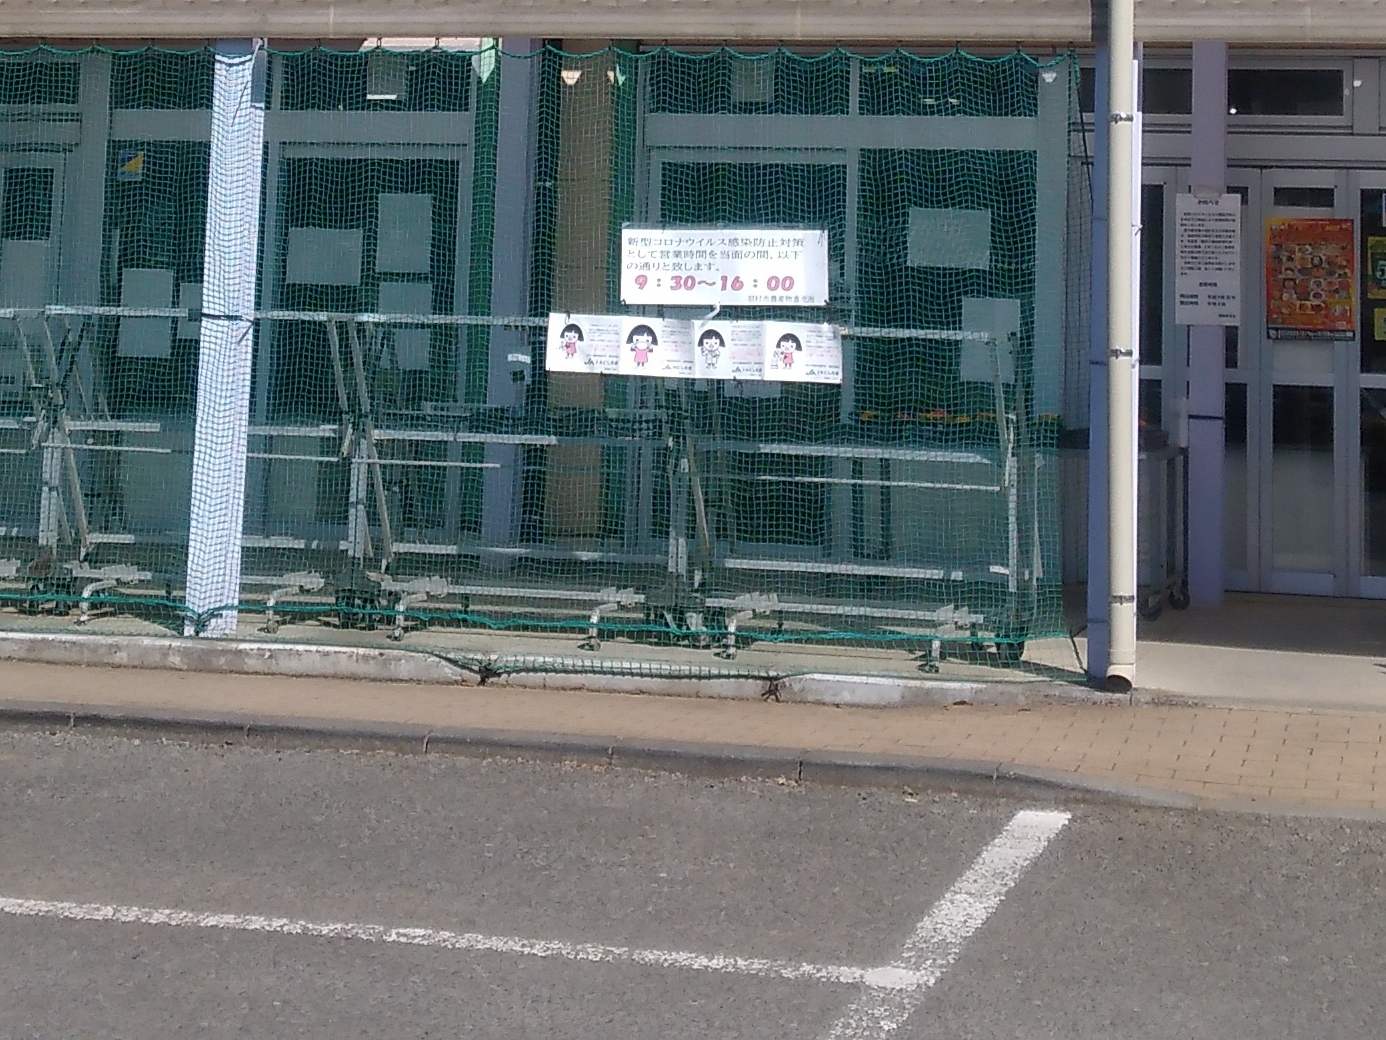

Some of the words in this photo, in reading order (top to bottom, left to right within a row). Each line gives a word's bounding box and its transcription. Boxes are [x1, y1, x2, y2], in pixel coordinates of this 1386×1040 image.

[627, 237, 805, 248] 新型コロナウイルス感染防止対策
[626, 262, 721, 272] の通りと致します。
